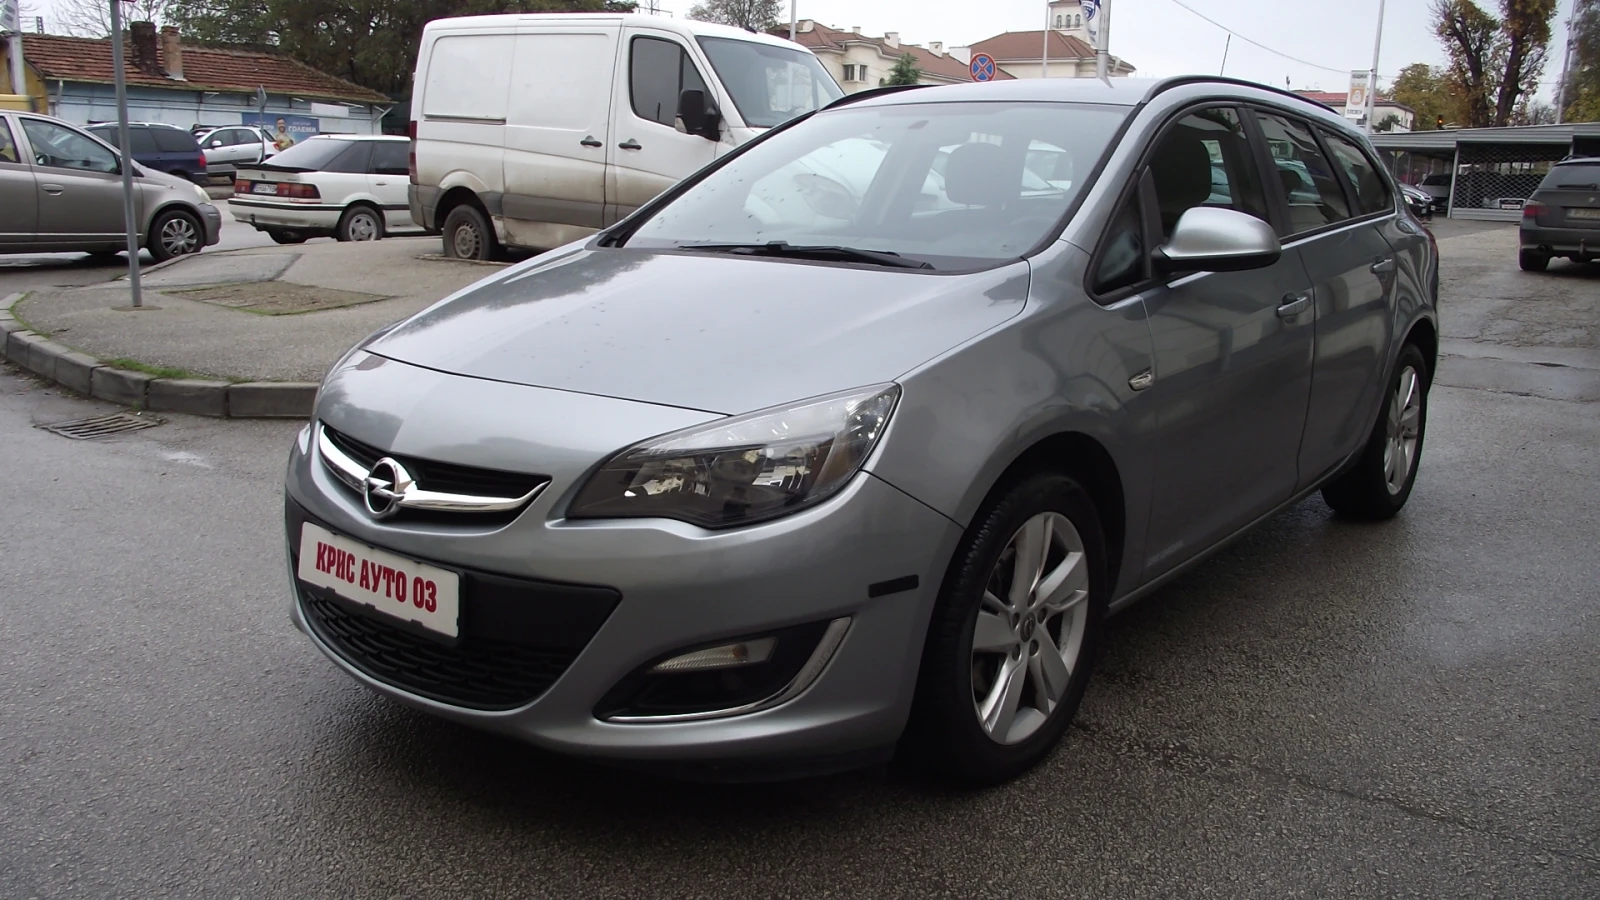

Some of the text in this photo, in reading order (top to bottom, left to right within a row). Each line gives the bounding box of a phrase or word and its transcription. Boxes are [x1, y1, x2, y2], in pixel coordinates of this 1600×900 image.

[288, 125, 317, 133] ГОЛЕМИ
[316, 541, 356, 584] КРИС
[359, 558, 407, 603] АУТО
